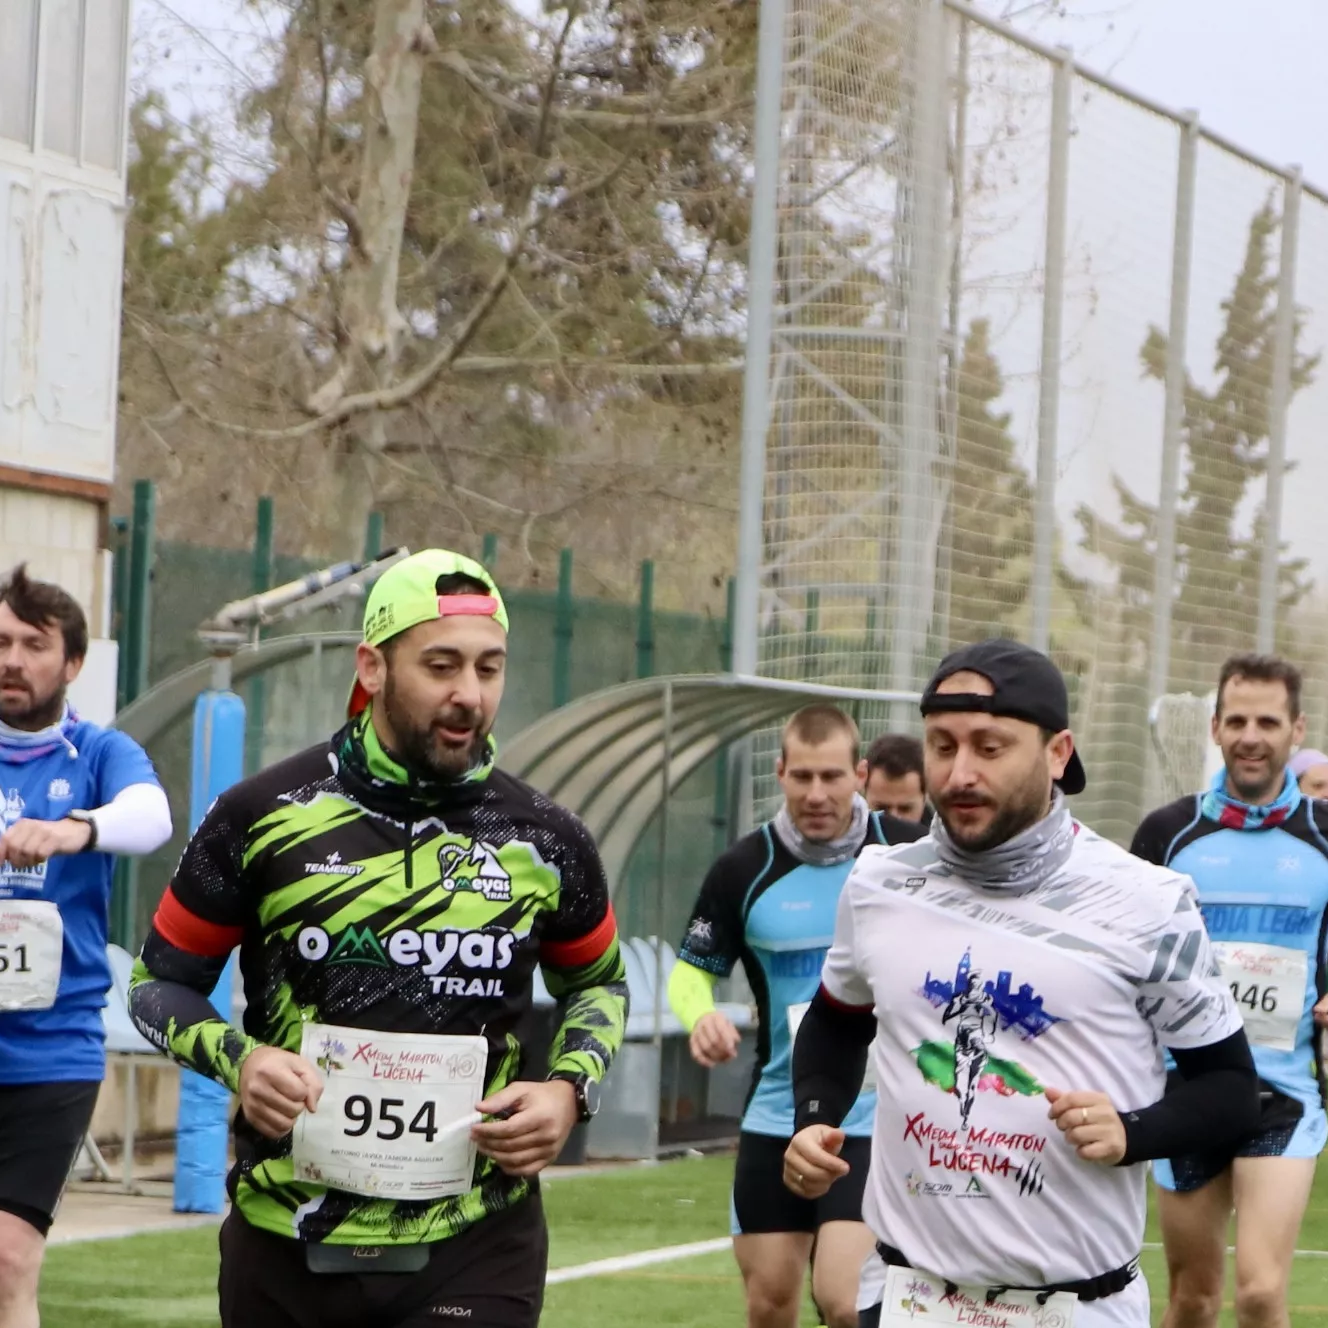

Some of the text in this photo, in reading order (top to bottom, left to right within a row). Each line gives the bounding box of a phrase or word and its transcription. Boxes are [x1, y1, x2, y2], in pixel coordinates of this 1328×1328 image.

[304, 862, 366, 876] TEAMERGY
[484, 891, 512, 901] TRAIL
[429, 976, 505, 997] TRAIL
[372, 1062, 430, 1083] LUCENA
[343, 1093, 439, 1144] 954
[929, 1143, 1022, 1178] LUCENA
